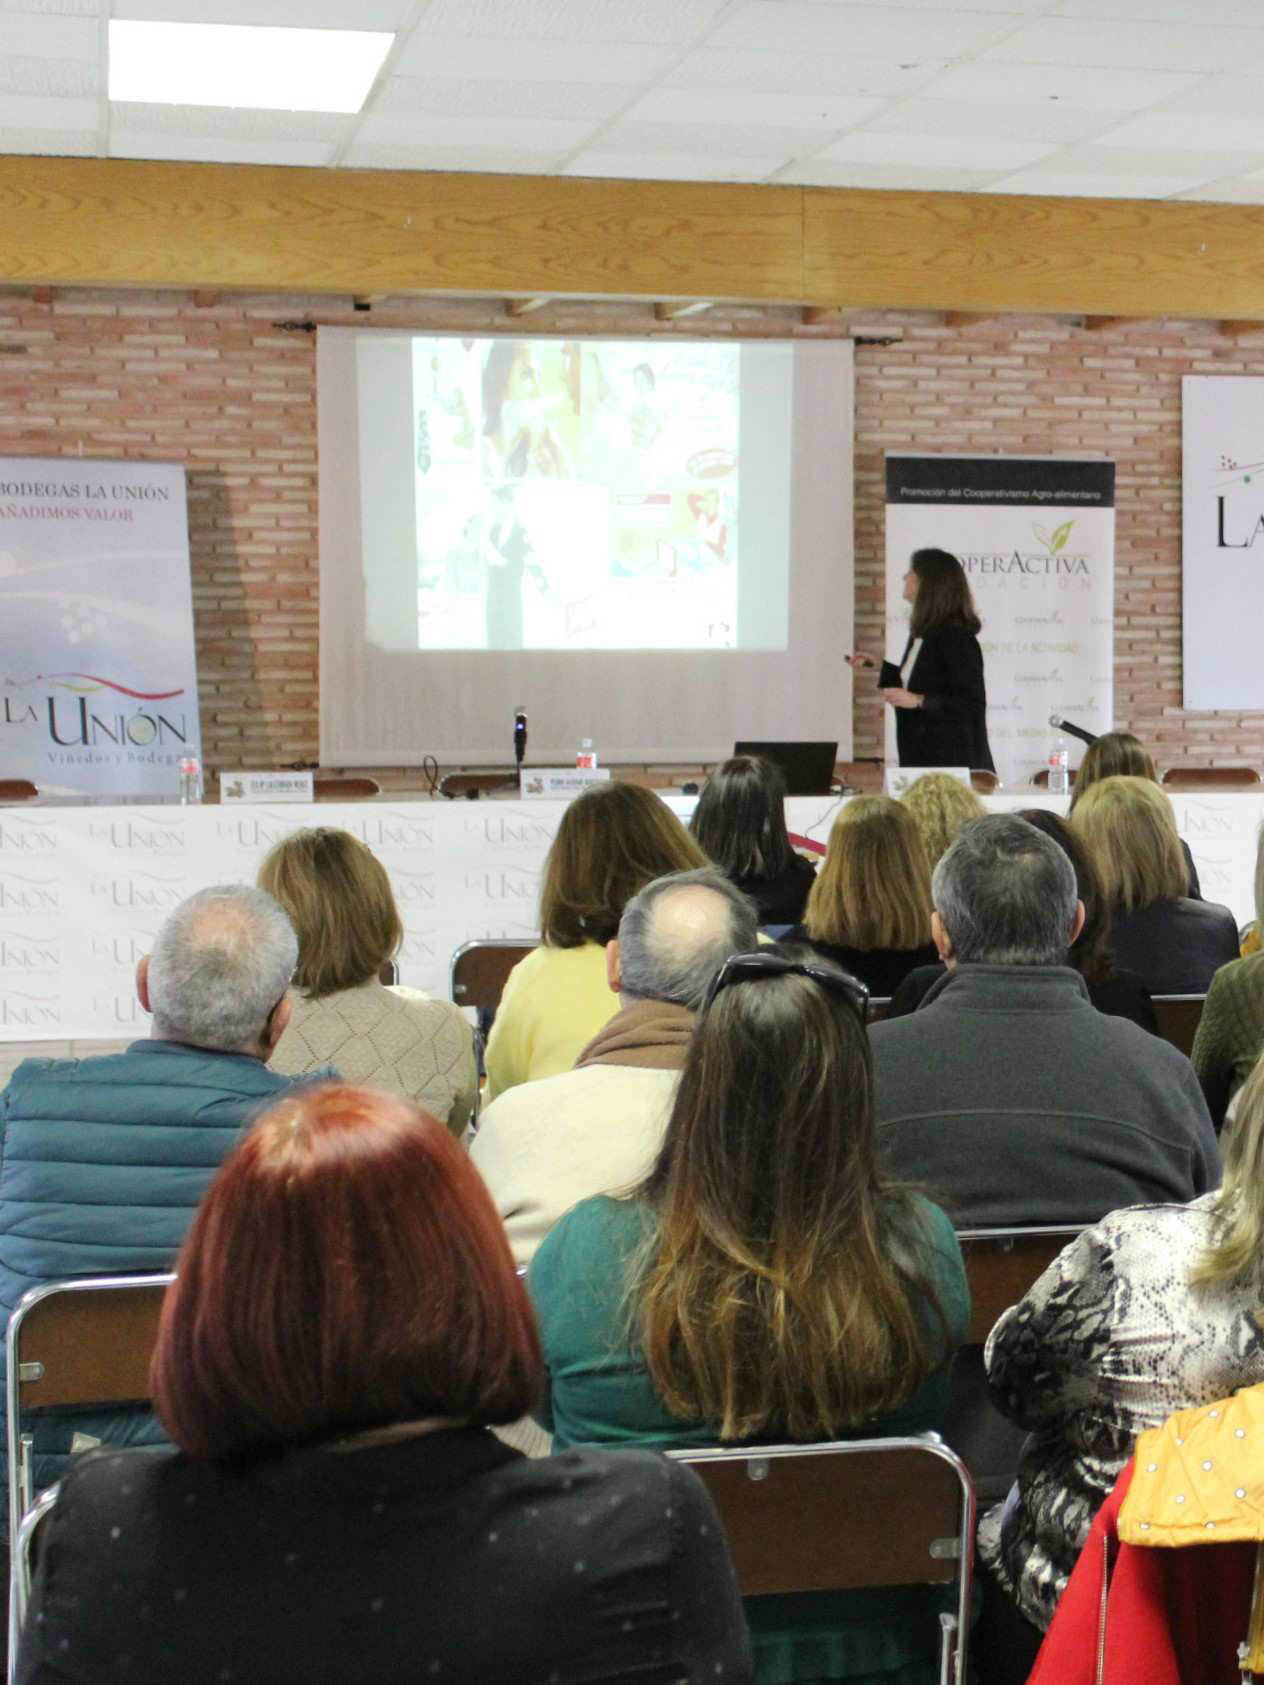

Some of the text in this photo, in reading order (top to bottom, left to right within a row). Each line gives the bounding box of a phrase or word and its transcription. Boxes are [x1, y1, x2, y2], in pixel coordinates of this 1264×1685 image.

[85, 483, 108, 500] LA
[112, 482, 169, 501] UNIÓN
[900, 486, 1101, 501] Promoción del Cooperativismo Agro-alimentario
[82, 505, 134, 522] VALOR
[4, 696, 188, 747] LA UNIÓN
